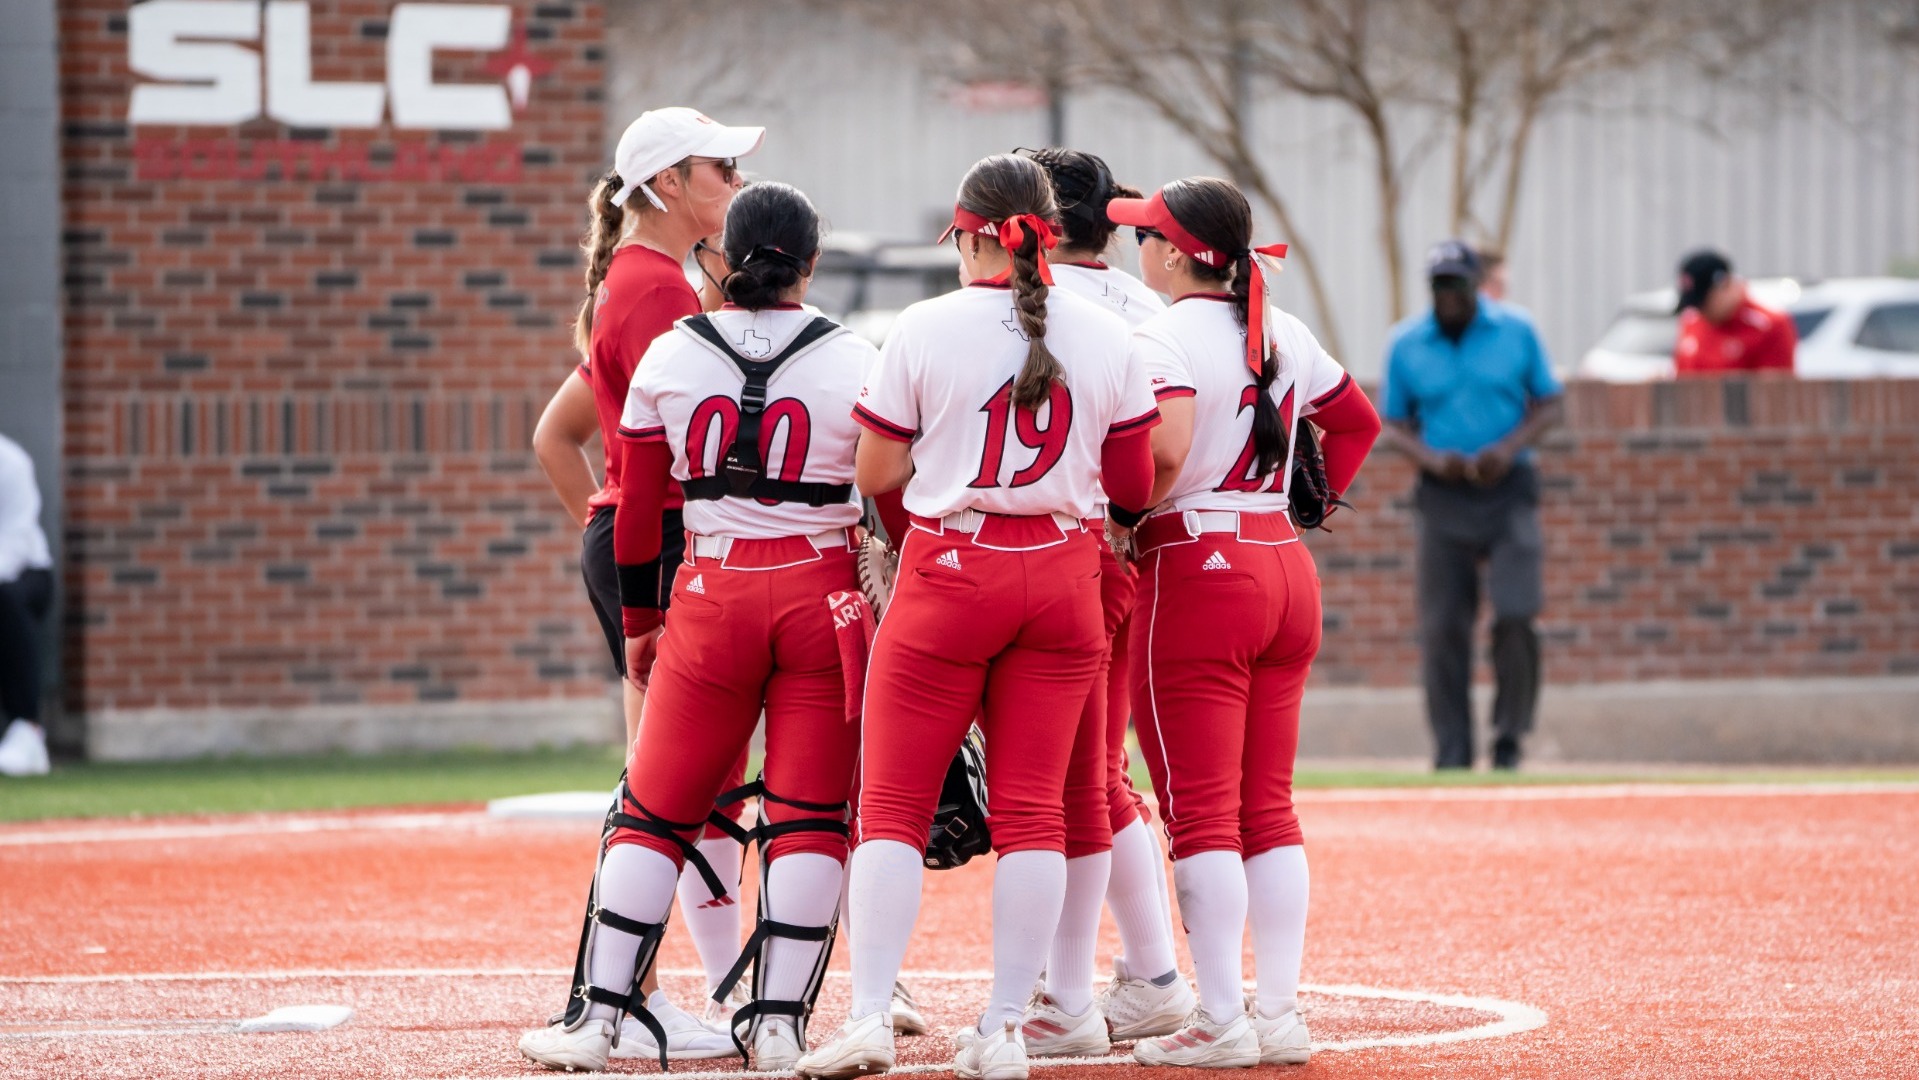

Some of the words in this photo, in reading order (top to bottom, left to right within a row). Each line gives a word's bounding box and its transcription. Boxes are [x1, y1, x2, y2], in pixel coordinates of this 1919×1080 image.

[128, 0, 512, 129] SLC
[134, 138, 525, 184] SOUTHLAND
[685, 394, 811, 506] 00
[966, 374, 1073, 488] 19
[1212, 381, 1295, 493] 21
[686, 584, 705, 595] adidas
[936, 557, 962, 571] adidas
[1202, 562, 1231, 570] adidas
